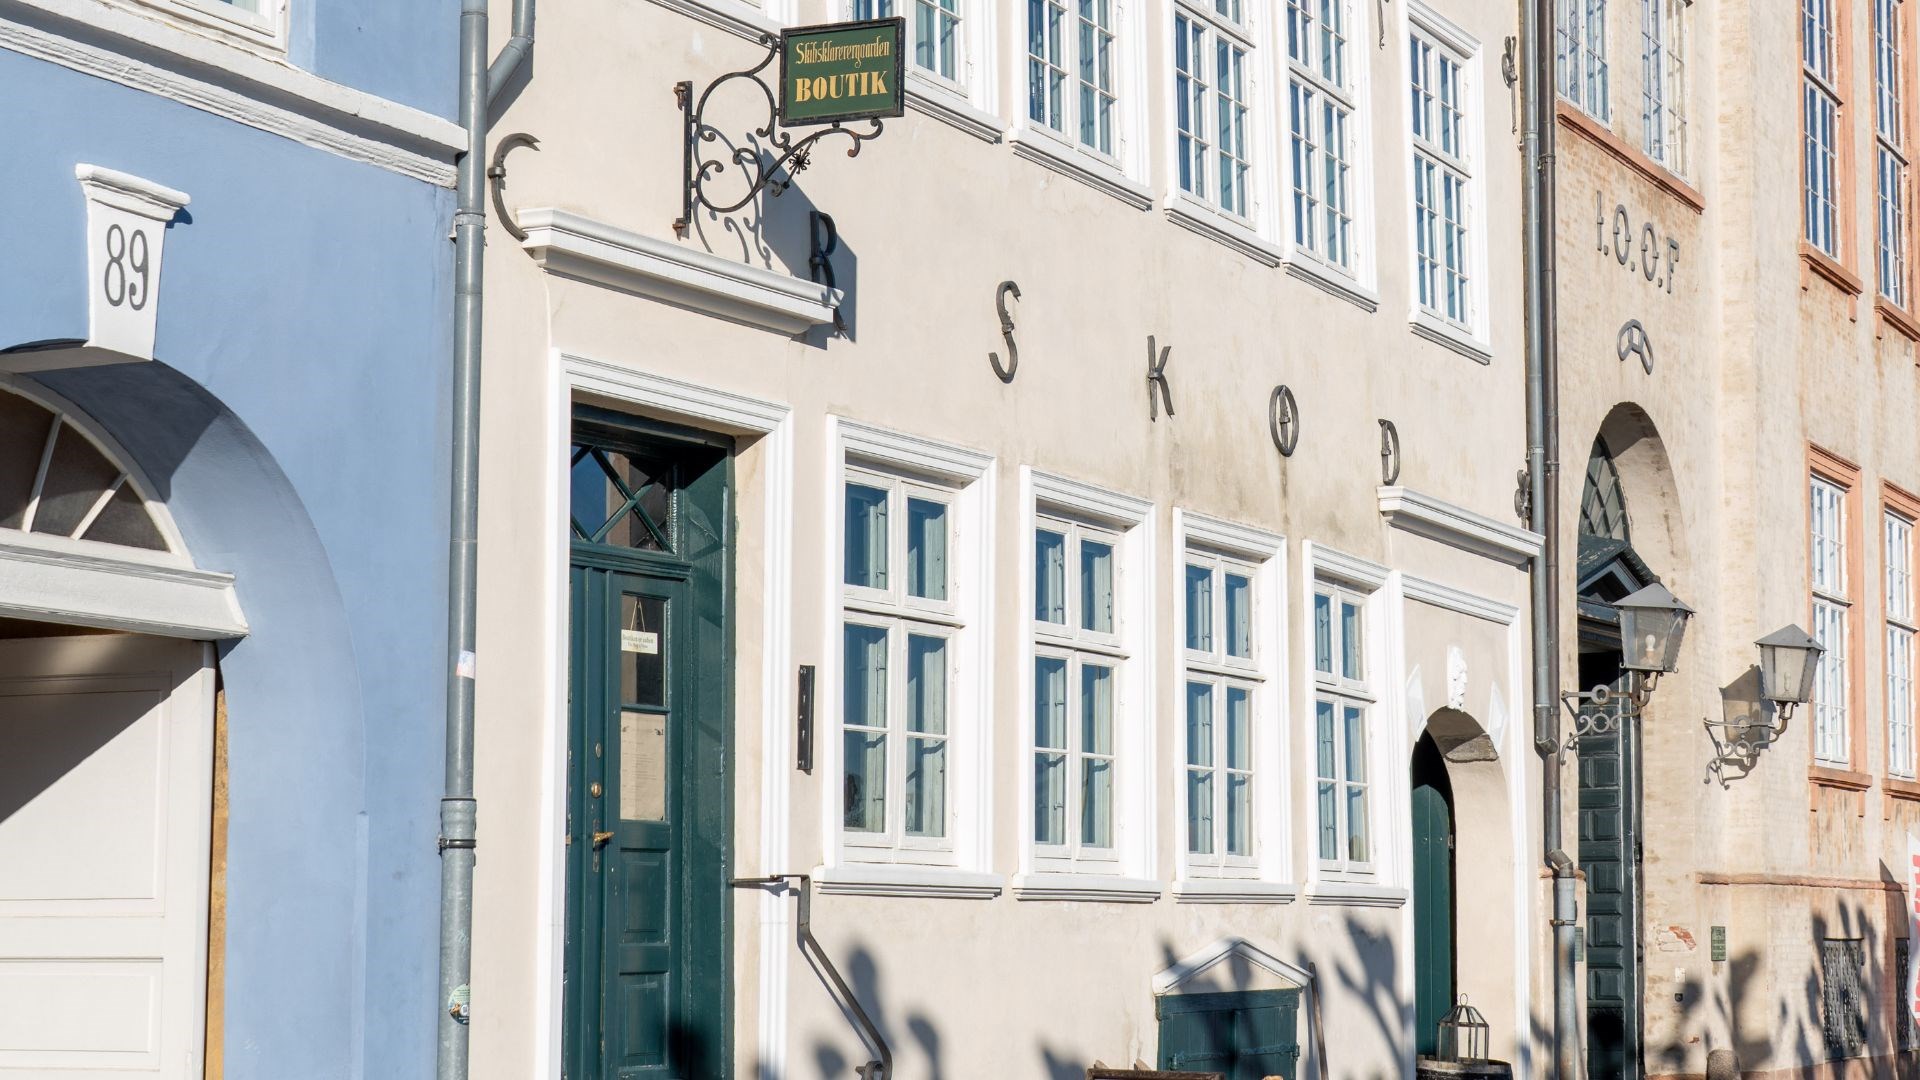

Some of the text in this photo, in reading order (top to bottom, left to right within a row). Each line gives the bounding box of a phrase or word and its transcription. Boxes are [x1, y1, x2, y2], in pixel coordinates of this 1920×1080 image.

[795, 36, 890, 69] Skibsklarerergaarden
[795, 70, 889, 102] BOUTIK
[104, 223, 149, 311] 89
[988, 280, 1022, 384] S
[1147, 335, 1176, 423] K
